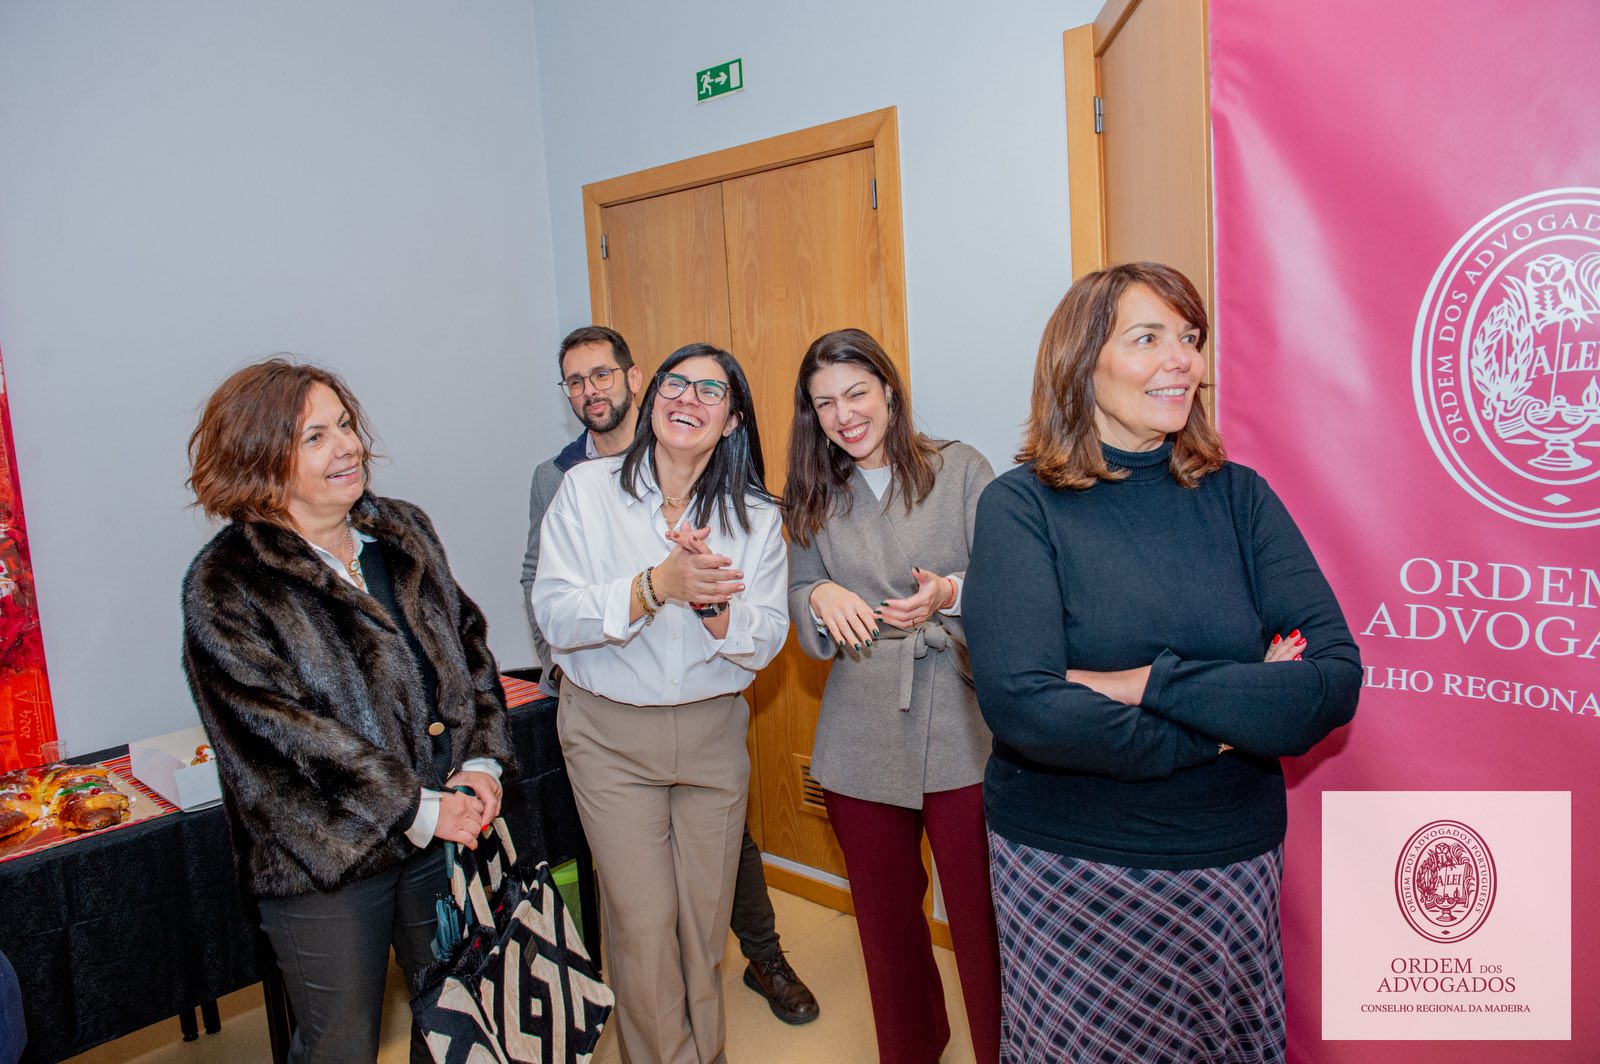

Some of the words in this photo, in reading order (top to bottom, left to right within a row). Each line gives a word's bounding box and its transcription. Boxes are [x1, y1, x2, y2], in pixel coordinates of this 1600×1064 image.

[1439, 290, 1468, 343] DOS
[1528, 345, 1554, 380] A
[1558, 341, 1600, 373] LE
[1437, 354, 1471, 444] ORDEM
